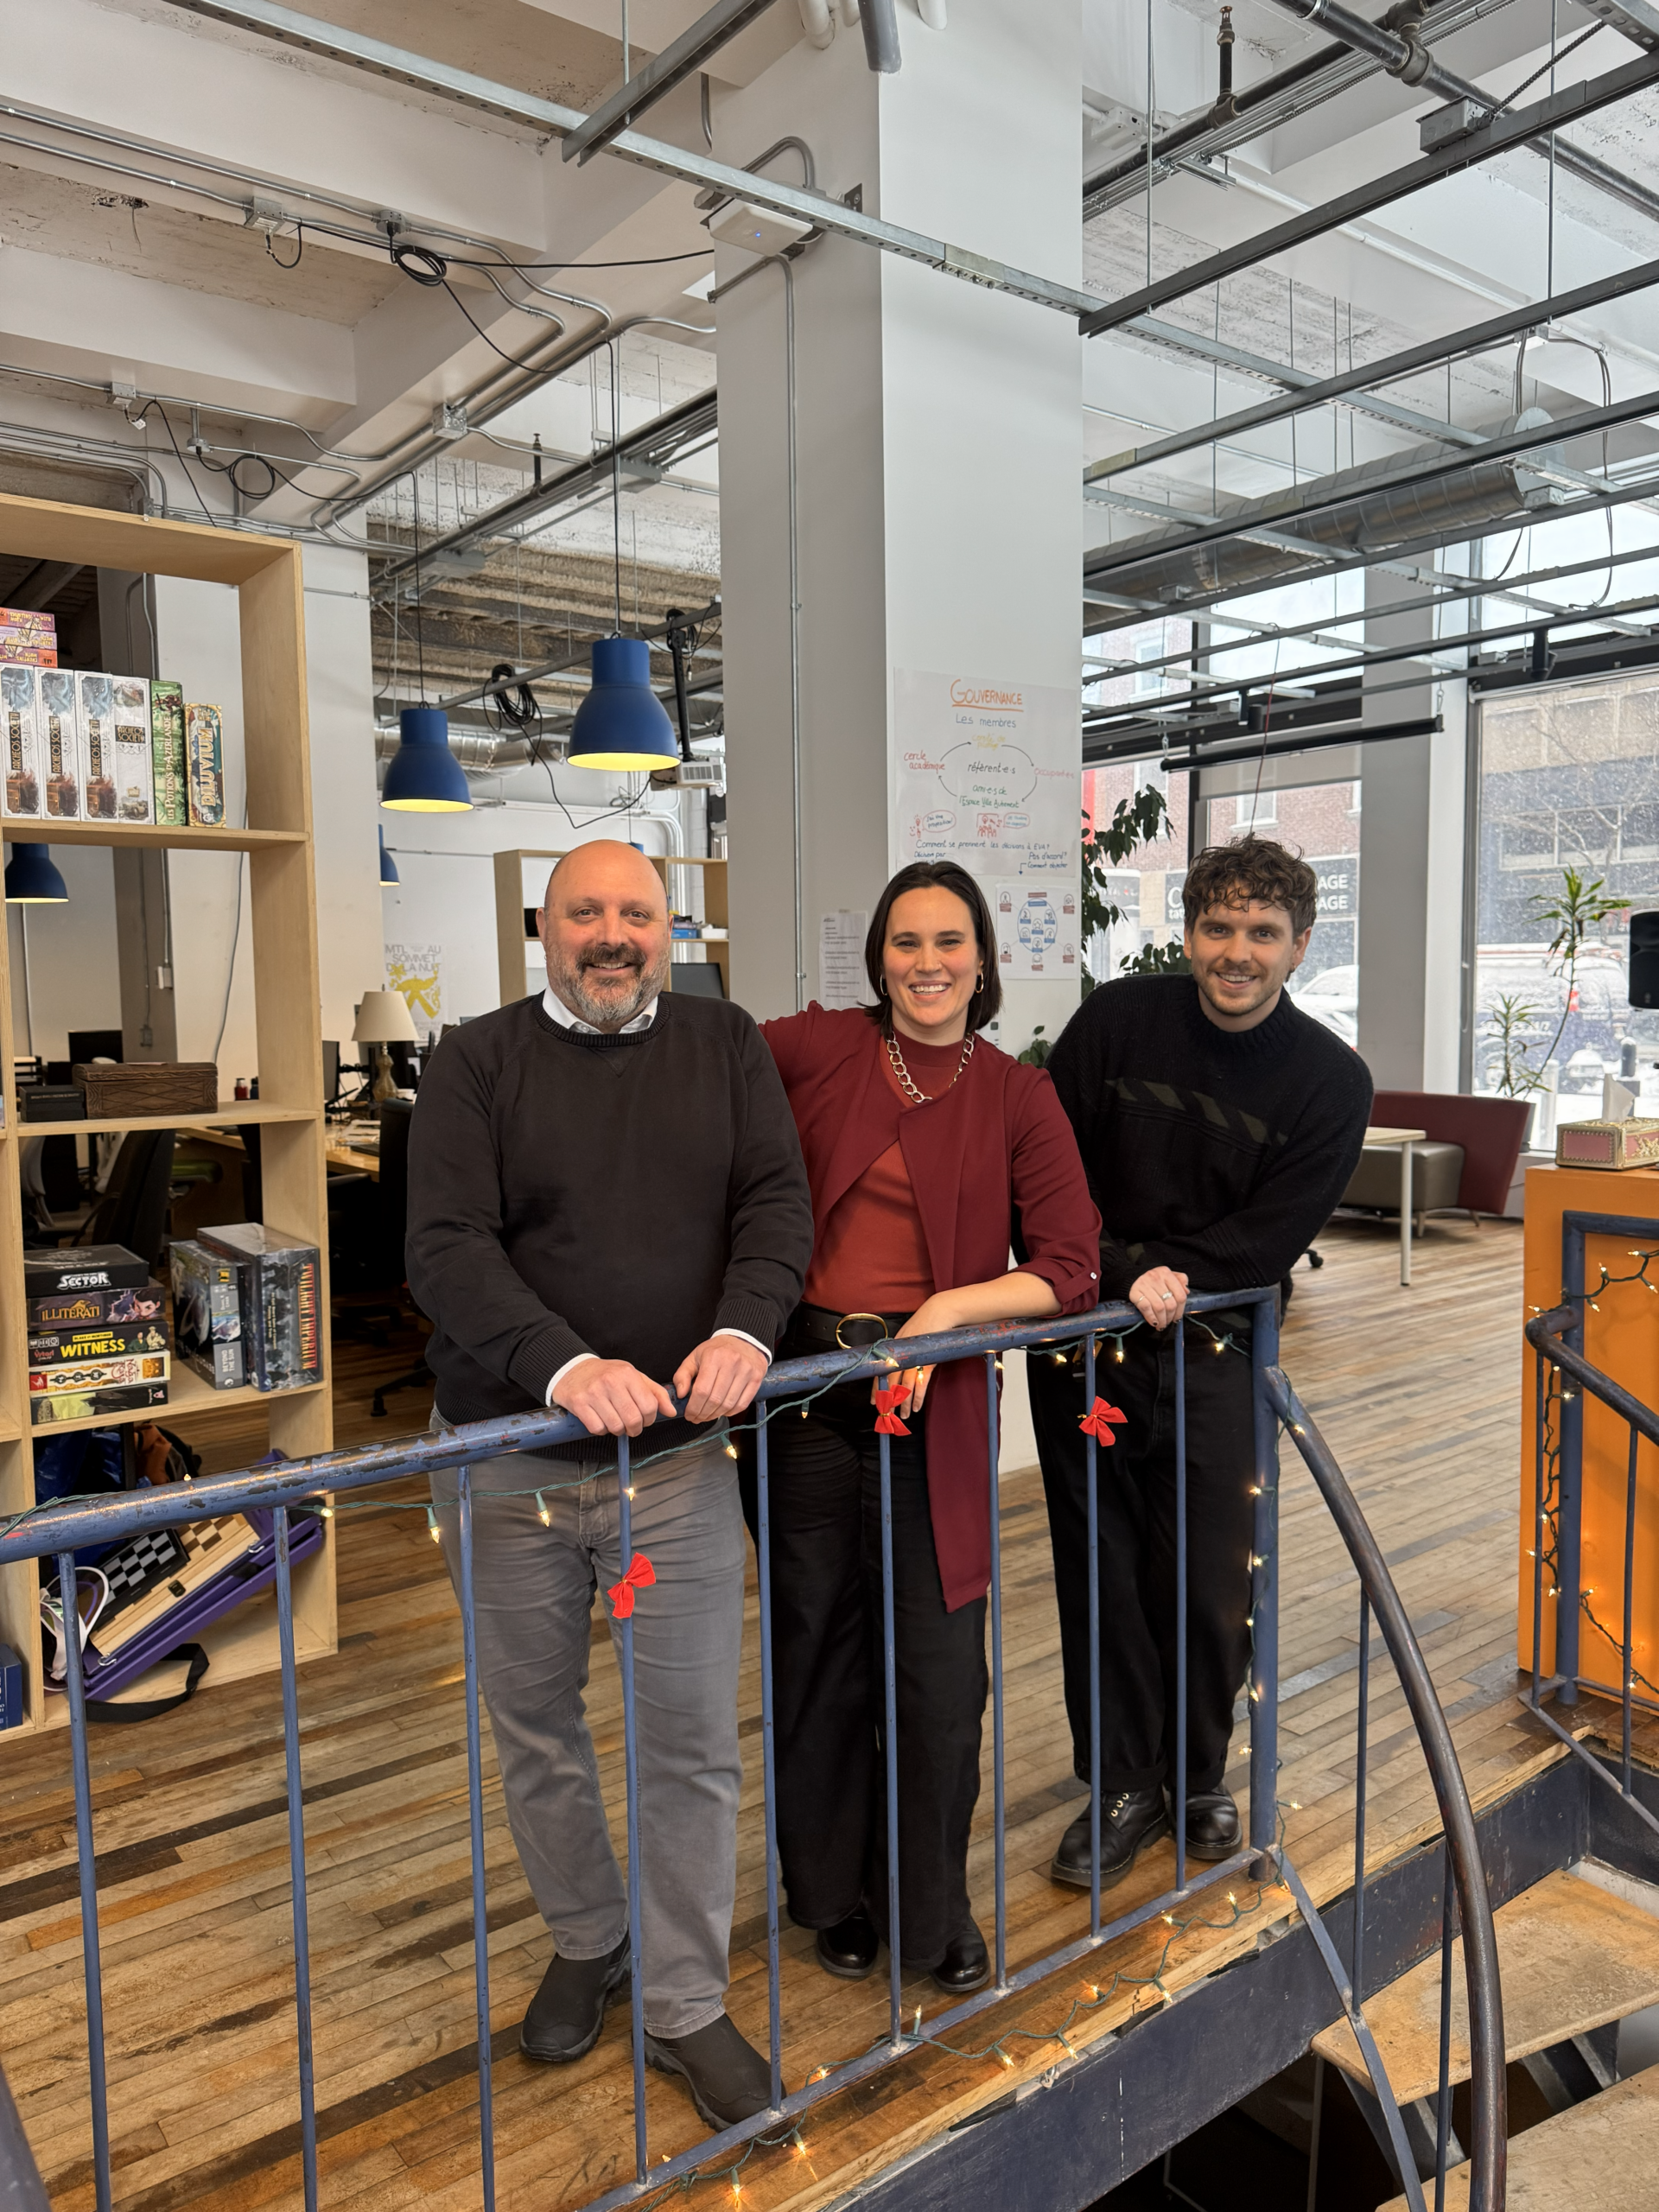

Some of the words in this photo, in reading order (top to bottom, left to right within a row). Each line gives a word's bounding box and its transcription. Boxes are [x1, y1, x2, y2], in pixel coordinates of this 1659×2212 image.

[10, 712, 20, 739] SOCIETY
[956, 713, 974, 724] Les
[980, 717, 1016, 728] membres
[11, 741, 22, 769] ARCHEOS
[52, 744, 62, 772] ARCHEOS
[91, 747, 101, 775] ARCHEOS
[198, 728, 216, 807] DILUVIUM
[165, 772, 175, 809] POTIONS
[916, 839, 947, 849] Comment
[385, 944, 408, 954] MTL
[428, 945, 442, 954] AU
[392, 953, 437, 963] SOMMET
[58, 1271, 110, 1287] SECTOR
[299, 1262, 315, 1315] TWILIGHT
[41, 1305, 100, 1322] ILLITERATI
[60, 1338, 125, 1358] WITNESS
[301, 1318, 318, 1370] IMPERIUM
